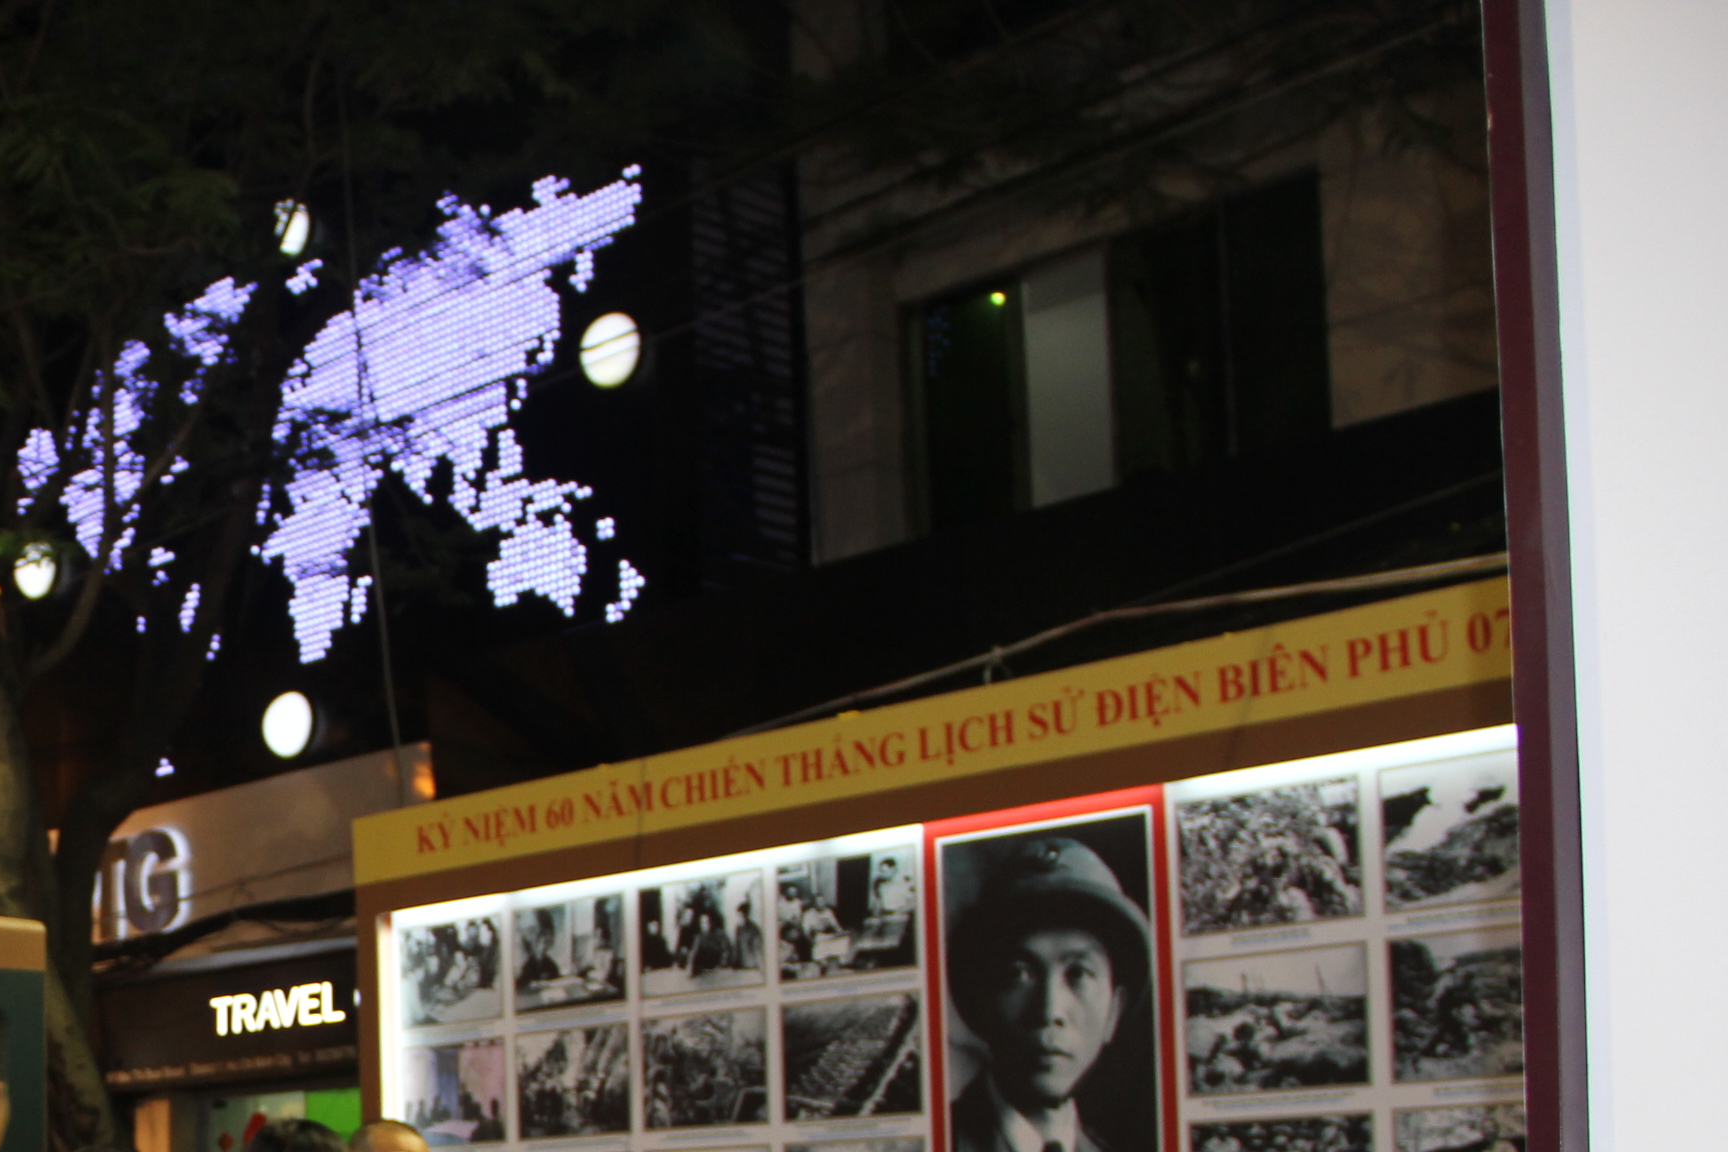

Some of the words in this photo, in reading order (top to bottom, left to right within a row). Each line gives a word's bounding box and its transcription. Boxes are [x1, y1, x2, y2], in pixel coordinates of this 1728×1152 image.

[545, 798, 575, 830] 60
[583, 780, 654, 823] NĂM
[660, 756, 766, 809] CHIẾN
[775, 731, 906, 787] THẮNG
[917, 710, 1015, 765] LỊCH
[1027, 687, 1085, 742] SỬ
[1217, 643, 1329, 704] BIÊN
[1345, 610, 1448, 679] PHỦ
[209, 981, 346, 1036] TRAVEL
